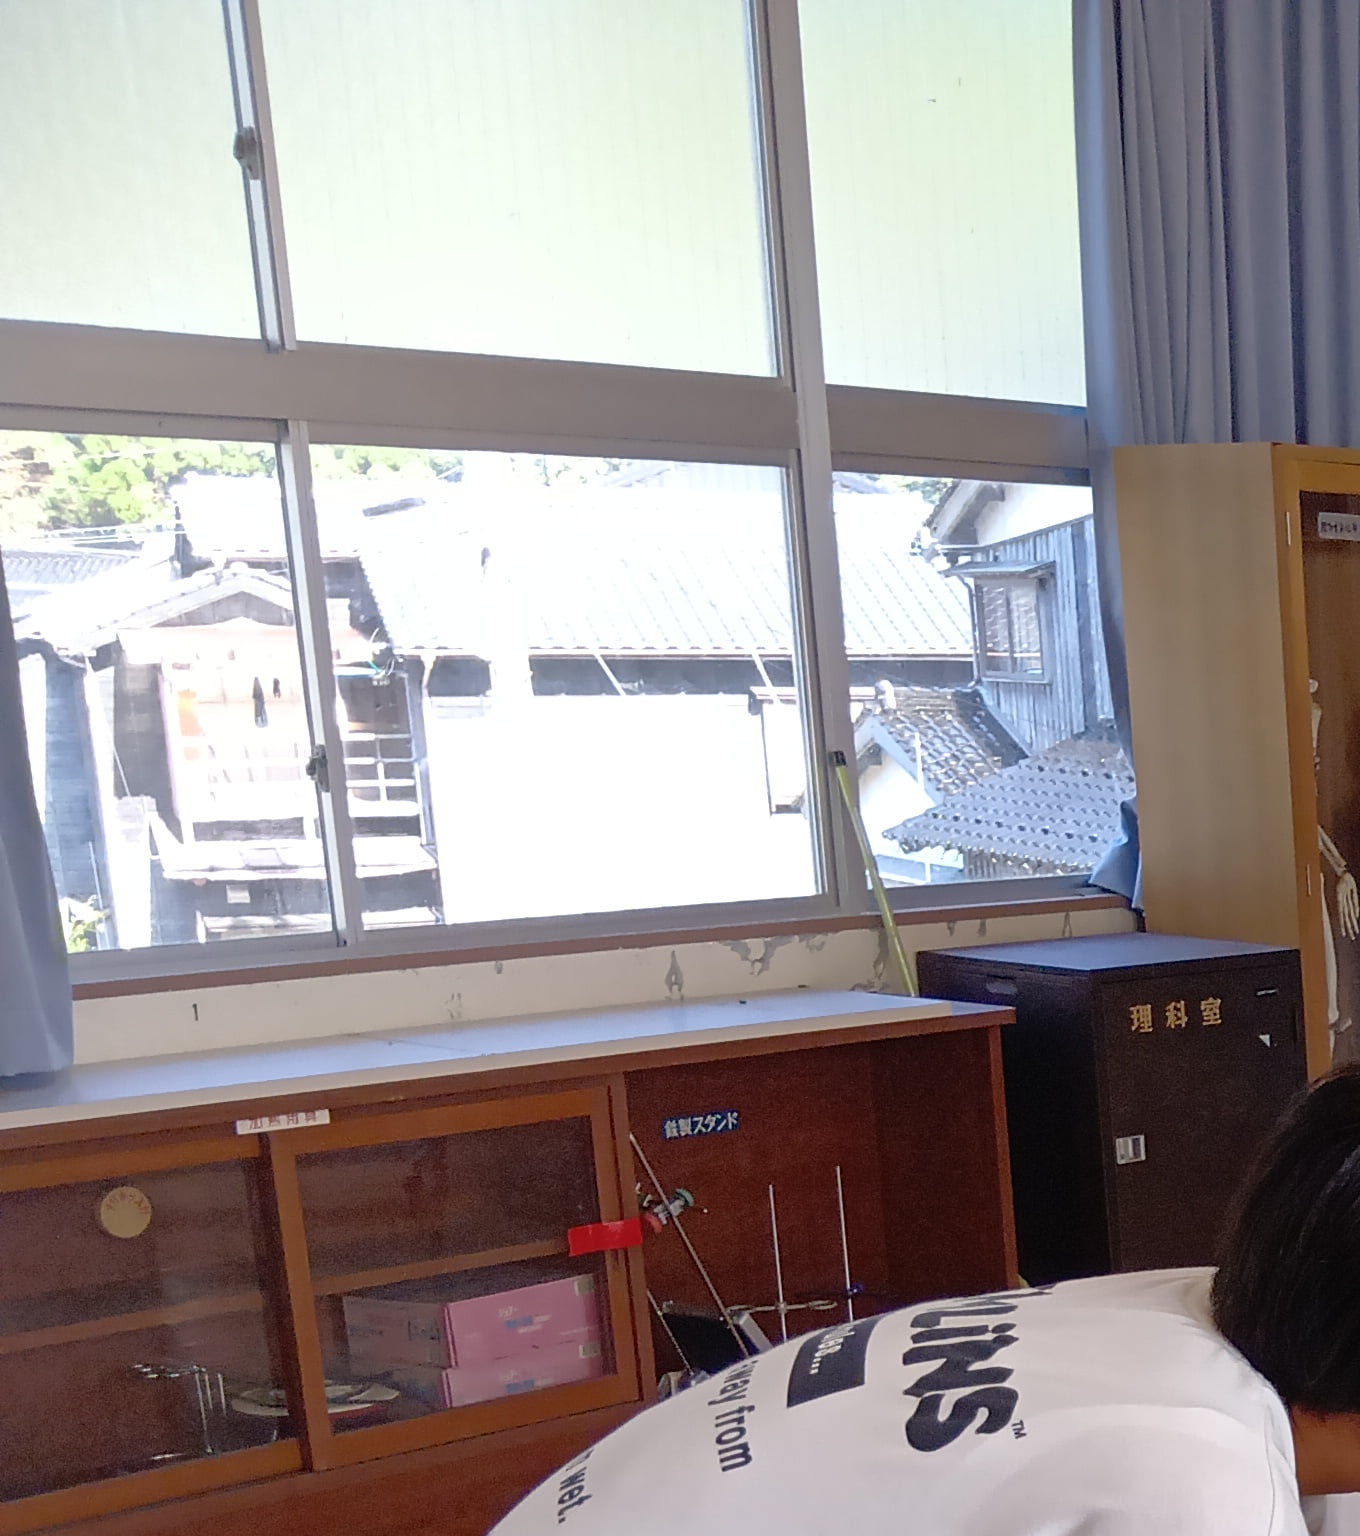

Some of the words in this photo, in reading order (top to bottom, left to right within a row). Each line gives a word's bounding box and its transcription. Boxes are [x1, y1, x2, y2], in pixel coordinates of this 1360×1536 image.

[1128, 996, 1222, 1034] 理科室
[715, 1404, 756, 1472] from
